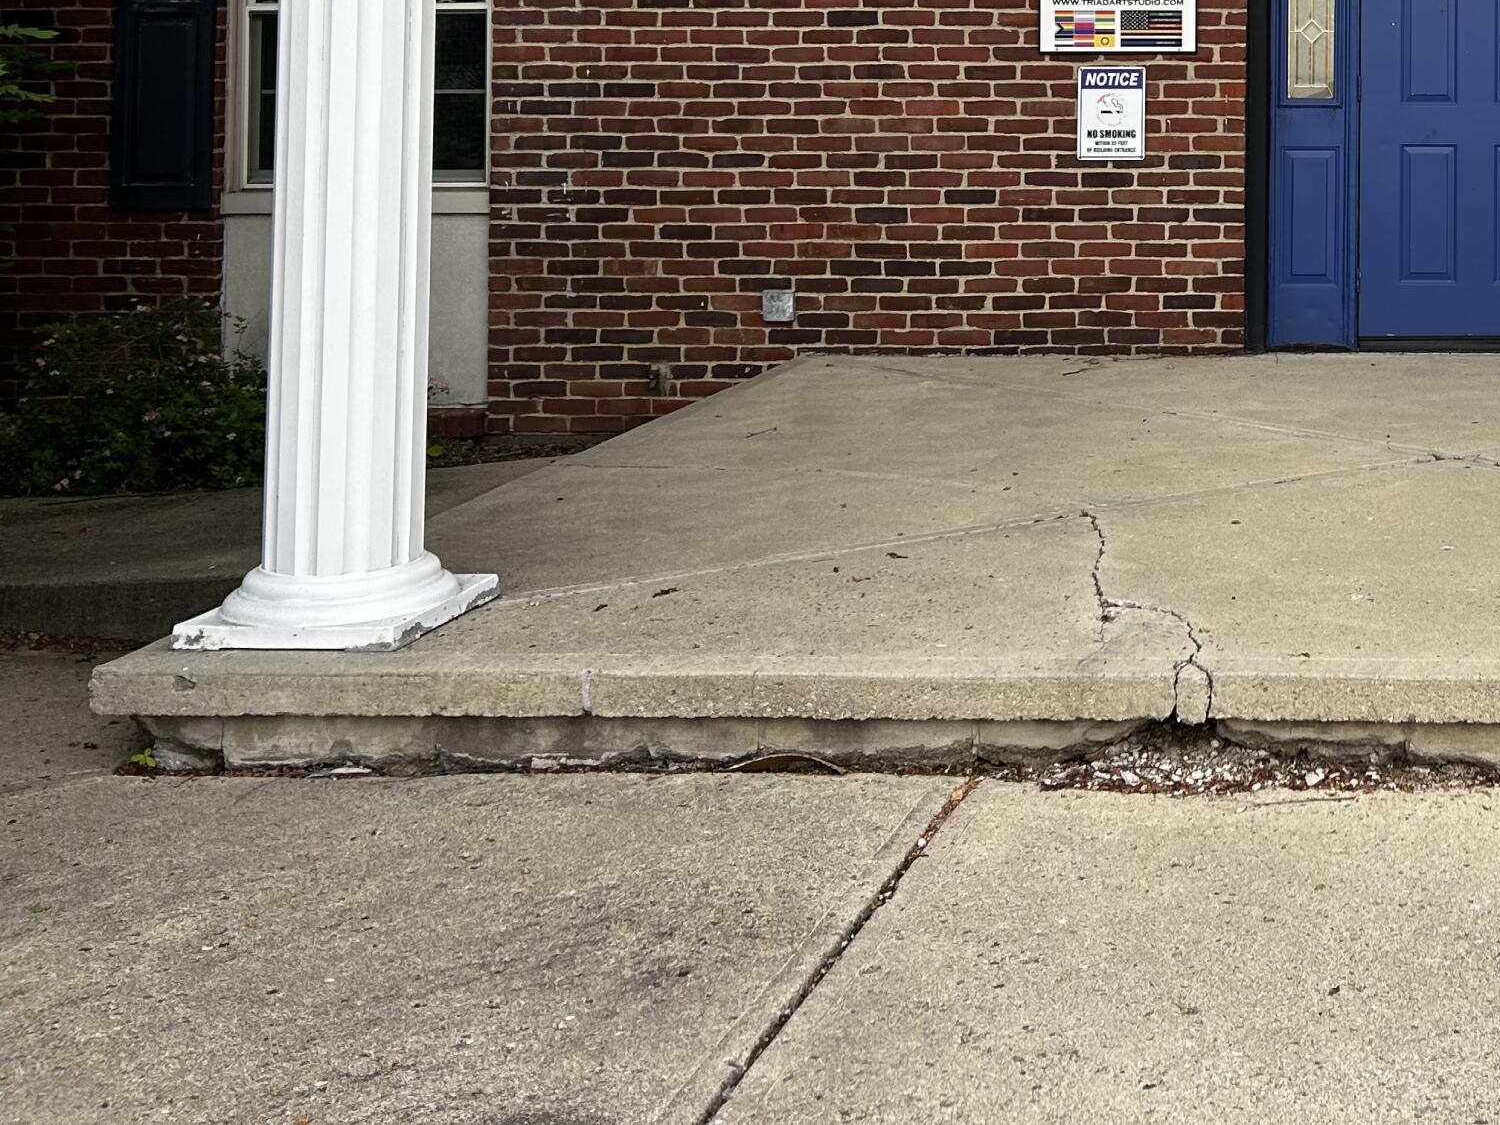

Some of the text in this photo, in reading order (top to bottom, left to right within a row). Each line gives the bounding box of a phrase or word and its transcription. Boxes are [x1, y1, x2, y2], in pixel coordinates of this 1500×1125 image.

[1085, 72, 1139, 86] NOTICE
[1087, 129, 1136, 139] NO SMOKING
